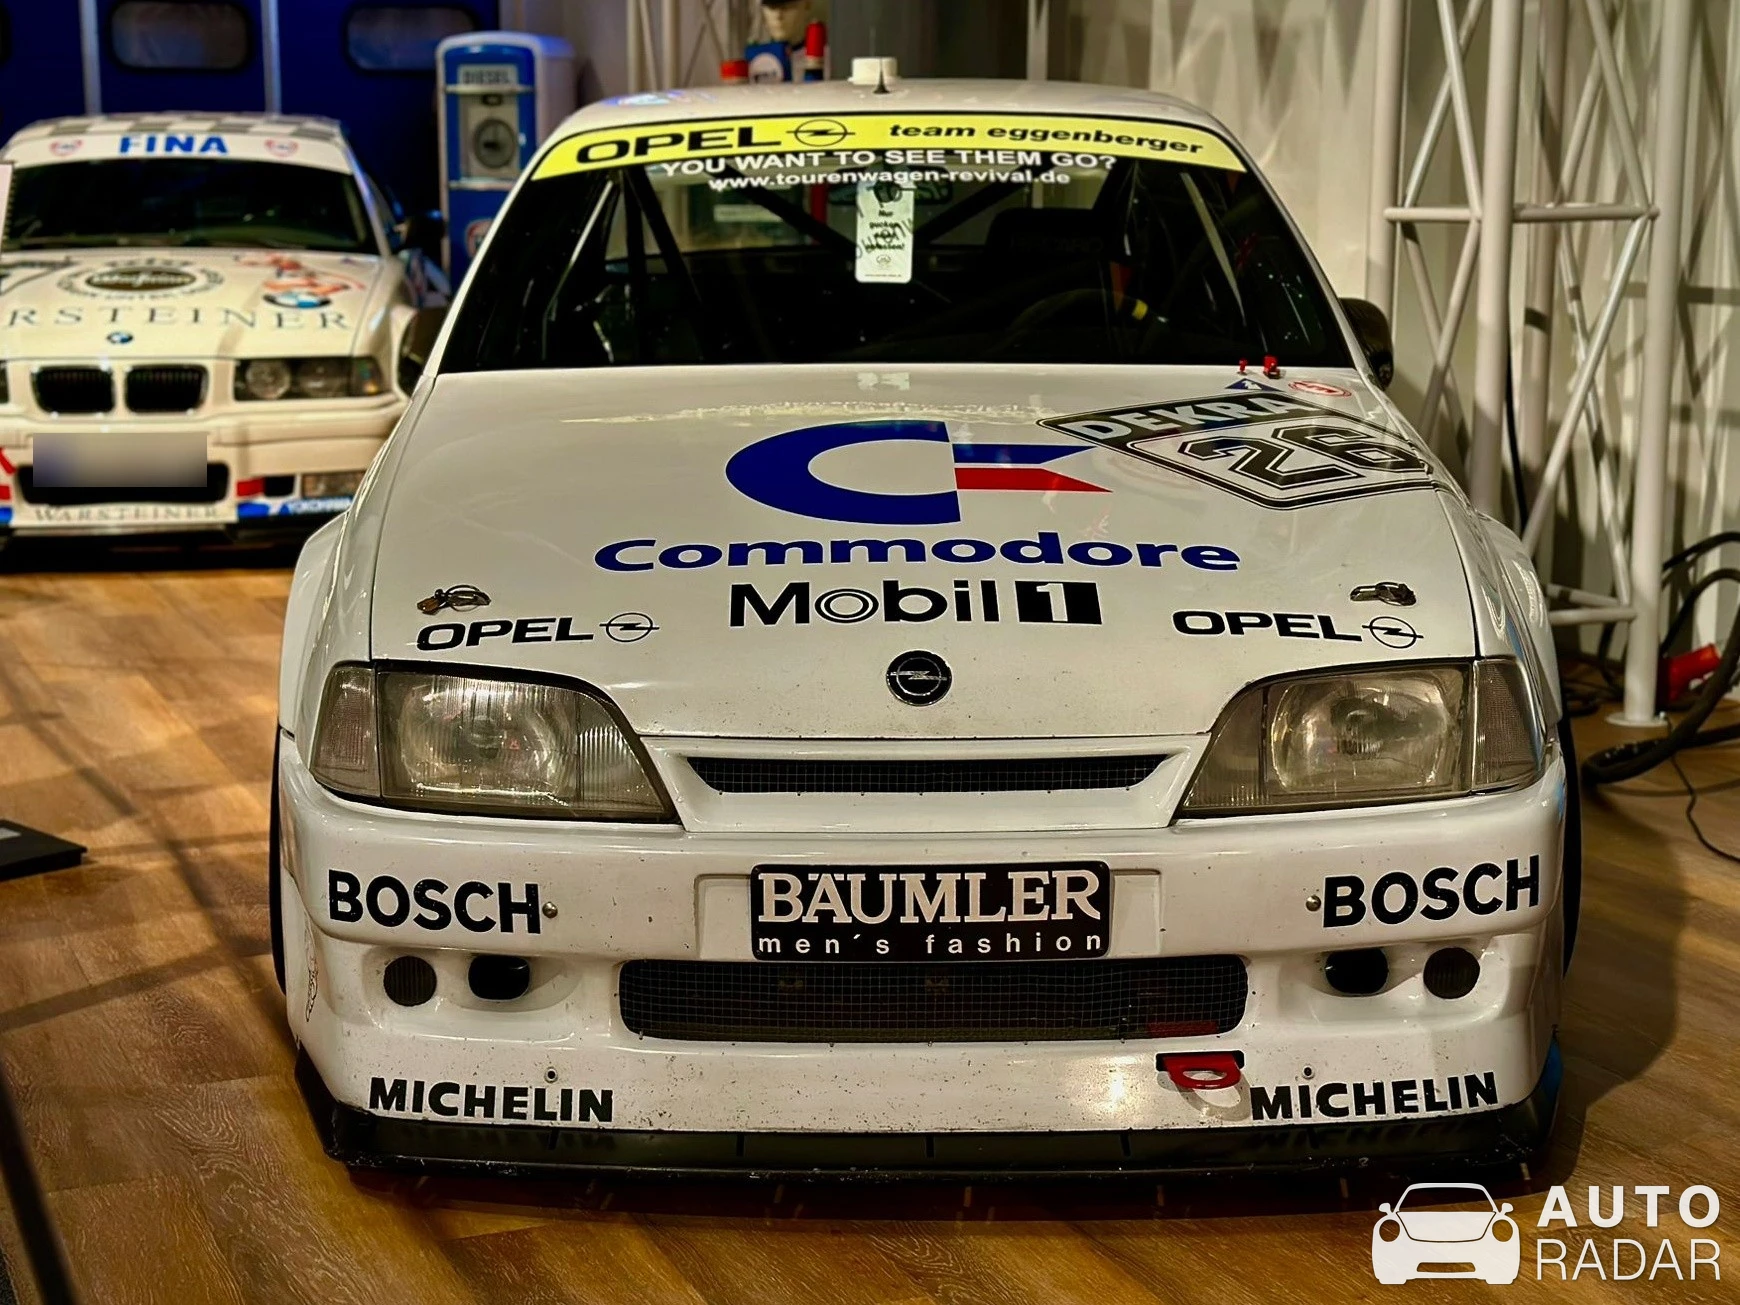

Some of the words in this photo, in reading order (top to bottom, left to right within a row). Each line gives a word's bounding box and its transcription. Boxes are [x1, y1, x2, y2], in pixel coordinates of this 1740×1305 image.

[119, 135, 228, 154] FINA
[576, 127, 781, 164] OPEL
[890, 123, 976, 138] team
[987, 126, 1205, 154] eggenberger
[662, 157, 726, 178] YOU
[735, 152, 826, 171] WANT
[833, 150, 876, 166] TO
[884, 149, 946, 165] SEE
[953, 149, 1042, 166] THEM
[1050, 152, 1117, 170] GO?
[708, 168, 1071, 191] www.tourenwagen-revival.de
[1059, 396, 1322, 439] DEKRA
[1178, 423, 1433, 491] 26
[594, 531, 1241, 571] Commodore
[729, 579, 1000, 627] Mobil
[416, 617, 594, 651] OPEL
[1173, 609, 1363, 642] OPEL
[328, 869, 541, 934] BOSCH
[757, 869, 1101, 925] BÄUMLER
[1322, 854, 1541, 928] BOSCH
[925, 932, 1101, 954] fashion
[368, 1076, 613, 1123] MICHELIN
[1250, 1071, 1498, 1121] MICHELIN
